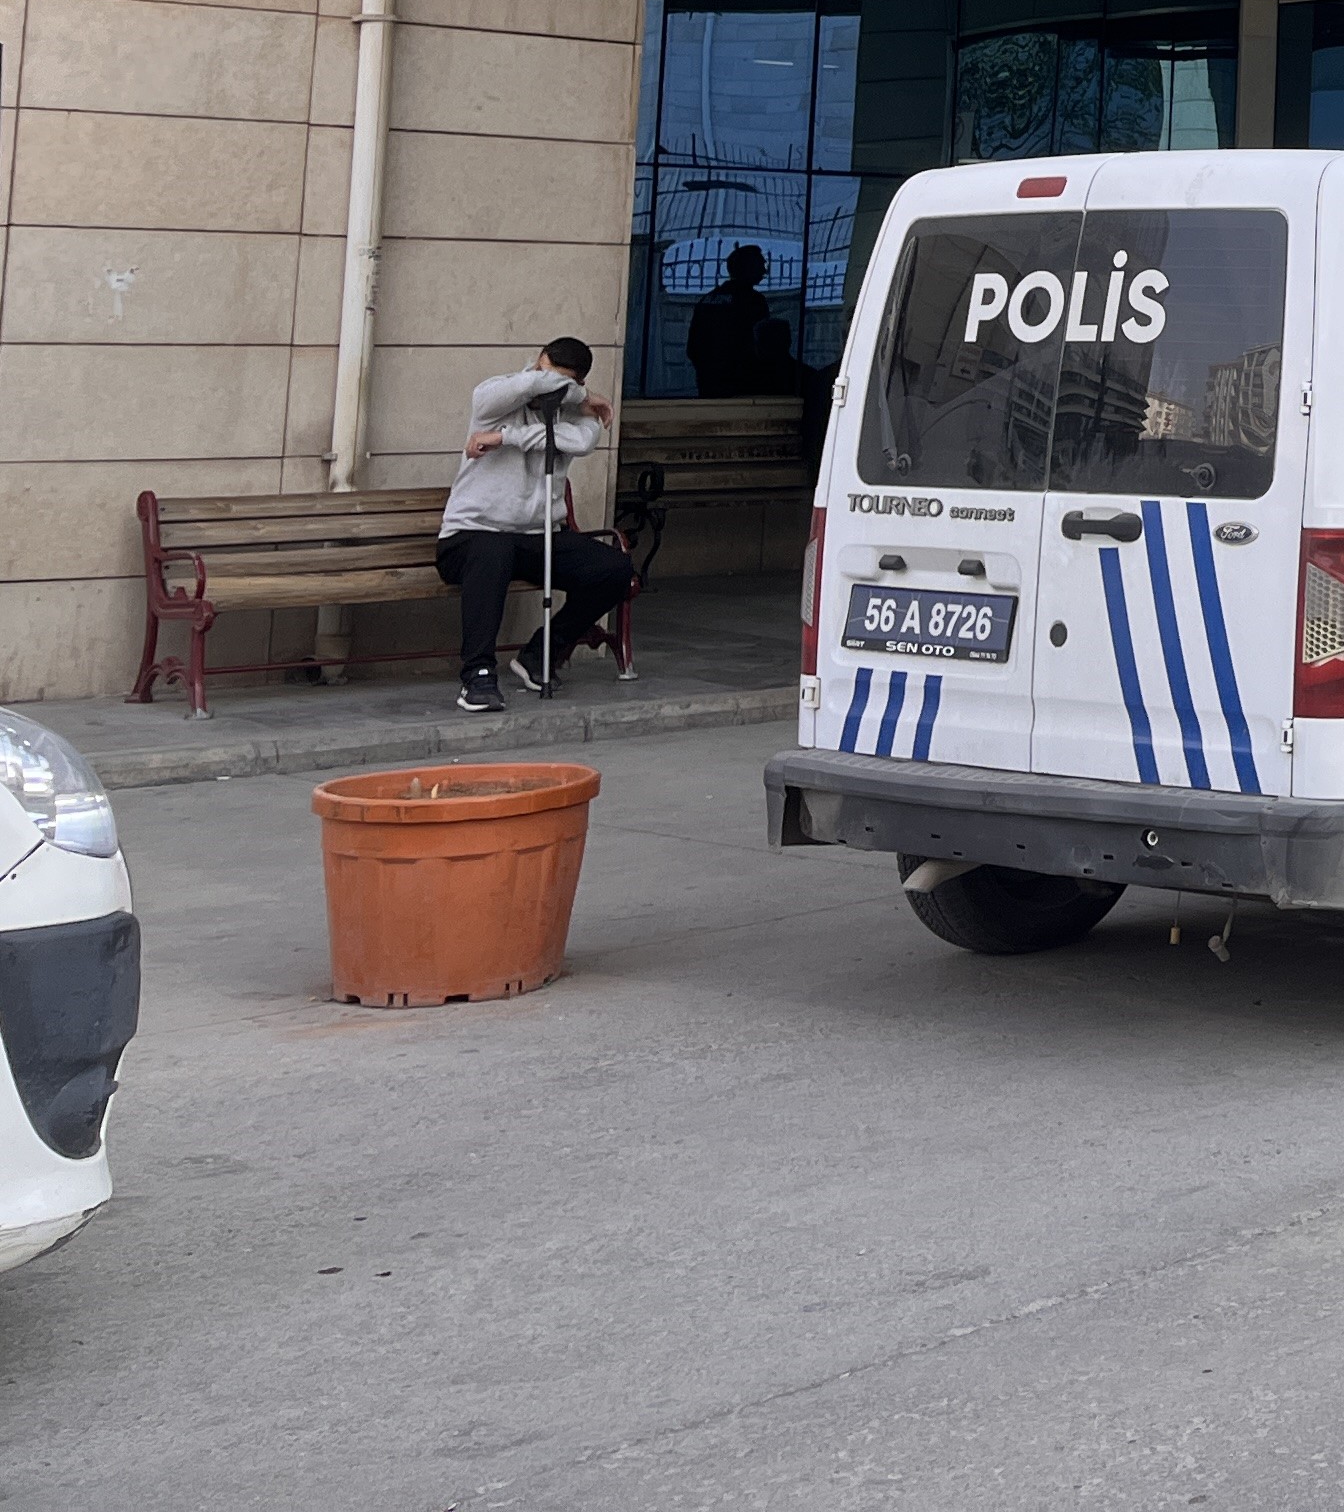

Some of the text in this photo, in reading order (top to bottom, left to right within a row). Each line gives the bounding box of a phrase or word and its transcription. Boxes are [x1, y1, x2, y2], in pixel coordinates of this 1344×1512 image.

[964, 249, 1170, 343] POLİS
[848, 494, 1015, 522] TOURNEO connect
[1220, 525, 1247, 539] Ford
[864, 597, 993, 641] 56 A 8726
[886, 641, 918, 653] SEN
[921, 643, 955, 656] OTO
